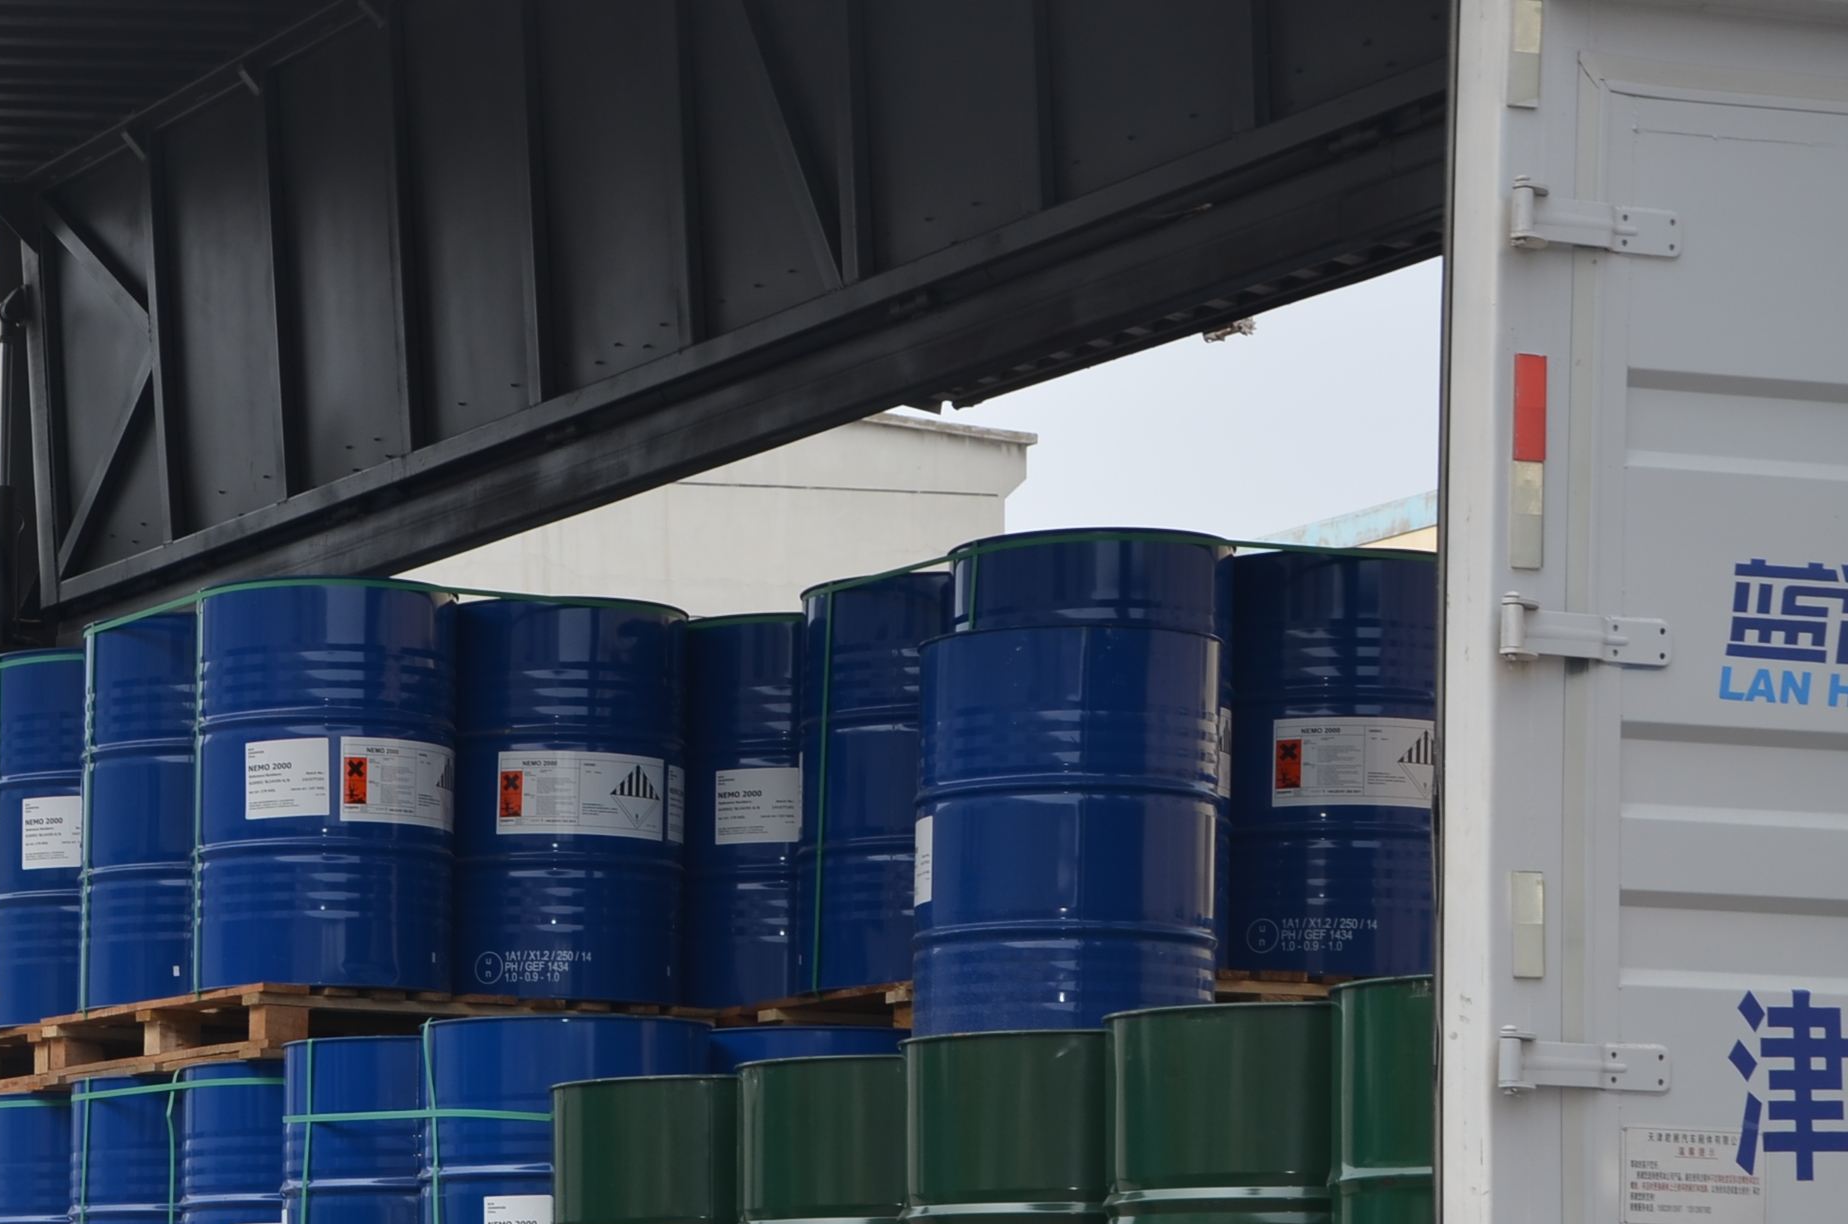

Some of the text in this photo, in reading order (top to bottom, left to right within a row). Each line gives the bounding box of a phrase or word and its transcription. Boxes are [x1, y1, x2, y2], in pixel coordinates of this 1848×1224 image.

[1726, 558, 1848, 664] 蓝
[1719, 666, 1811, 706] LAN
[248, 762, 292, 772] NEMO 2000
[717, 791, 740, 799] NEMO
[25, 817, 64, 826] NEMO 2000
[1339, 918, 1358, 929] 250
[1367, 919, 1378, 929] 14
[1281, 930, 1296, 940] PH
[1304, 929, 1326, 940] GEF
[505, 951, 521, 960] 1A1
[528, 950, 550, 961] X1.2
[557, 950, 573, 961] 250
[582, 952, 592, 961] 14
[505, 962, 518, 971] PH
[525, 961, 545, 971] GEF
[547, 962, 569, 971] 1434
[505, 972, 517, 982] 1.0
[524, 972, 539, 982] 0.9
[547, 972, 560, 982] 1.0
[1728, 990, 1848, 1181] 津
